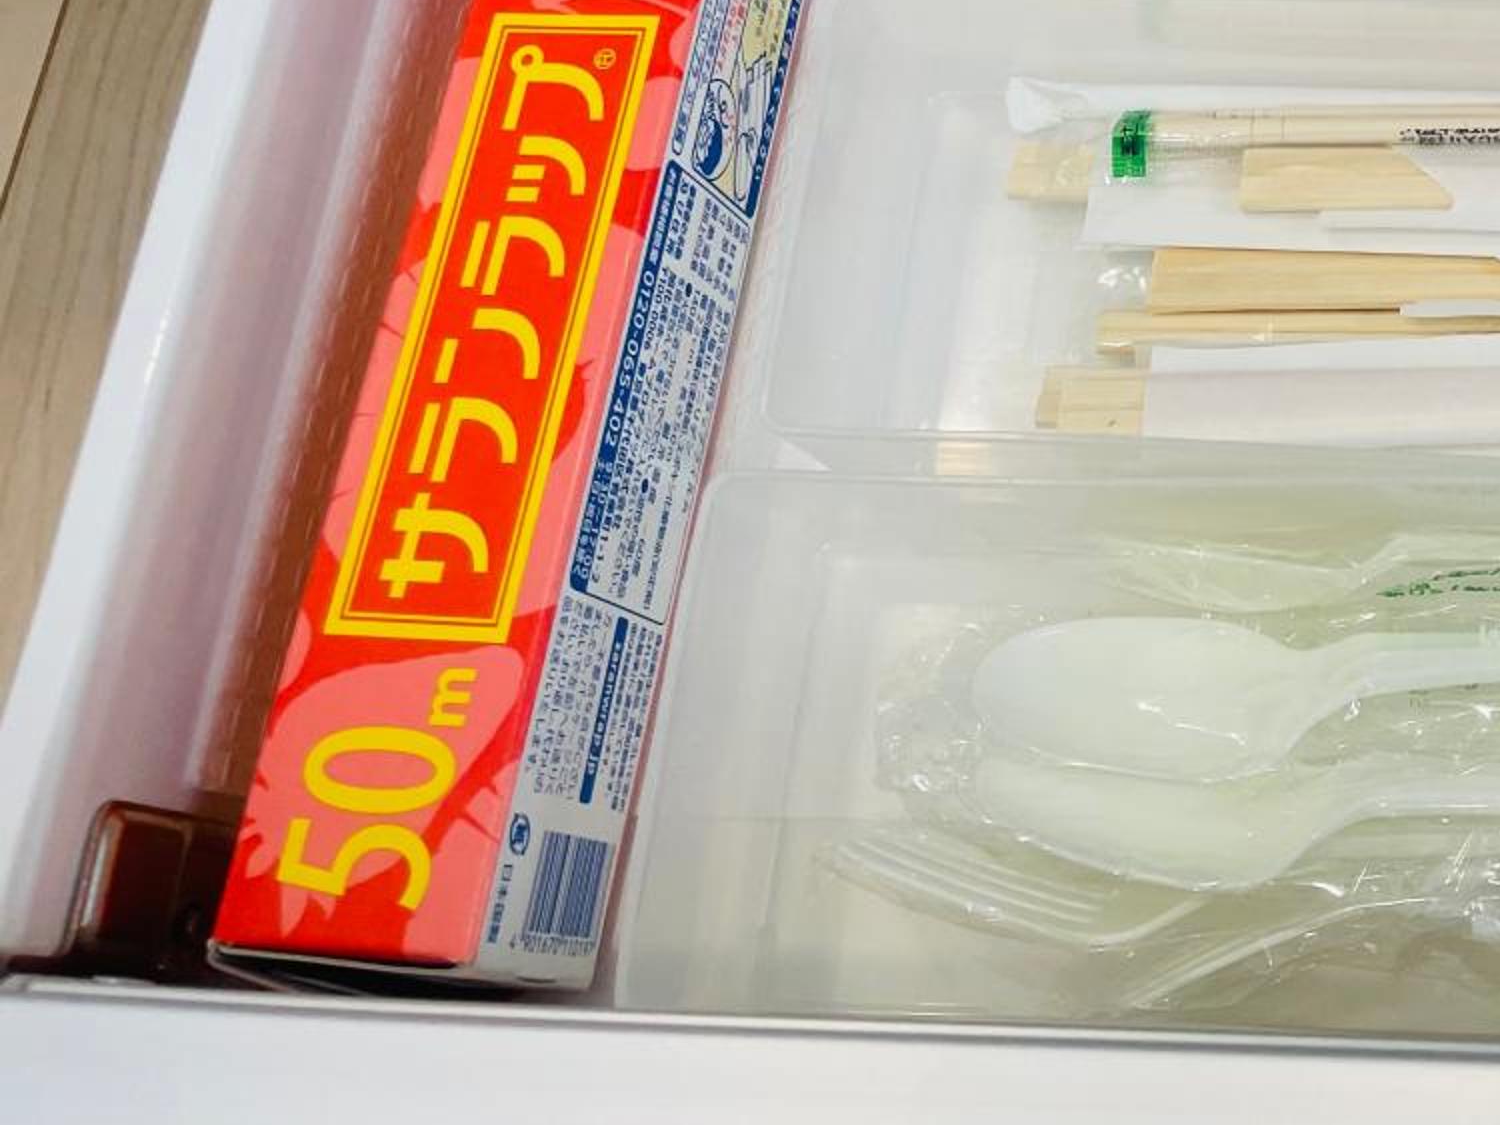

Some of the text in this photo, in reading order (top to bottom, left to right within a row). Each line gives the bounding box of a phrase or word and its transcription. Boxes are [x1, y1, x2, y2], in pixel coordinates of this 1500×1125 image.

[378, 43, 605, 600] サランラップ
[603, 267, 653, 448] 0120-065-402
[583, 639, 623, 776] saranwrap.jp
